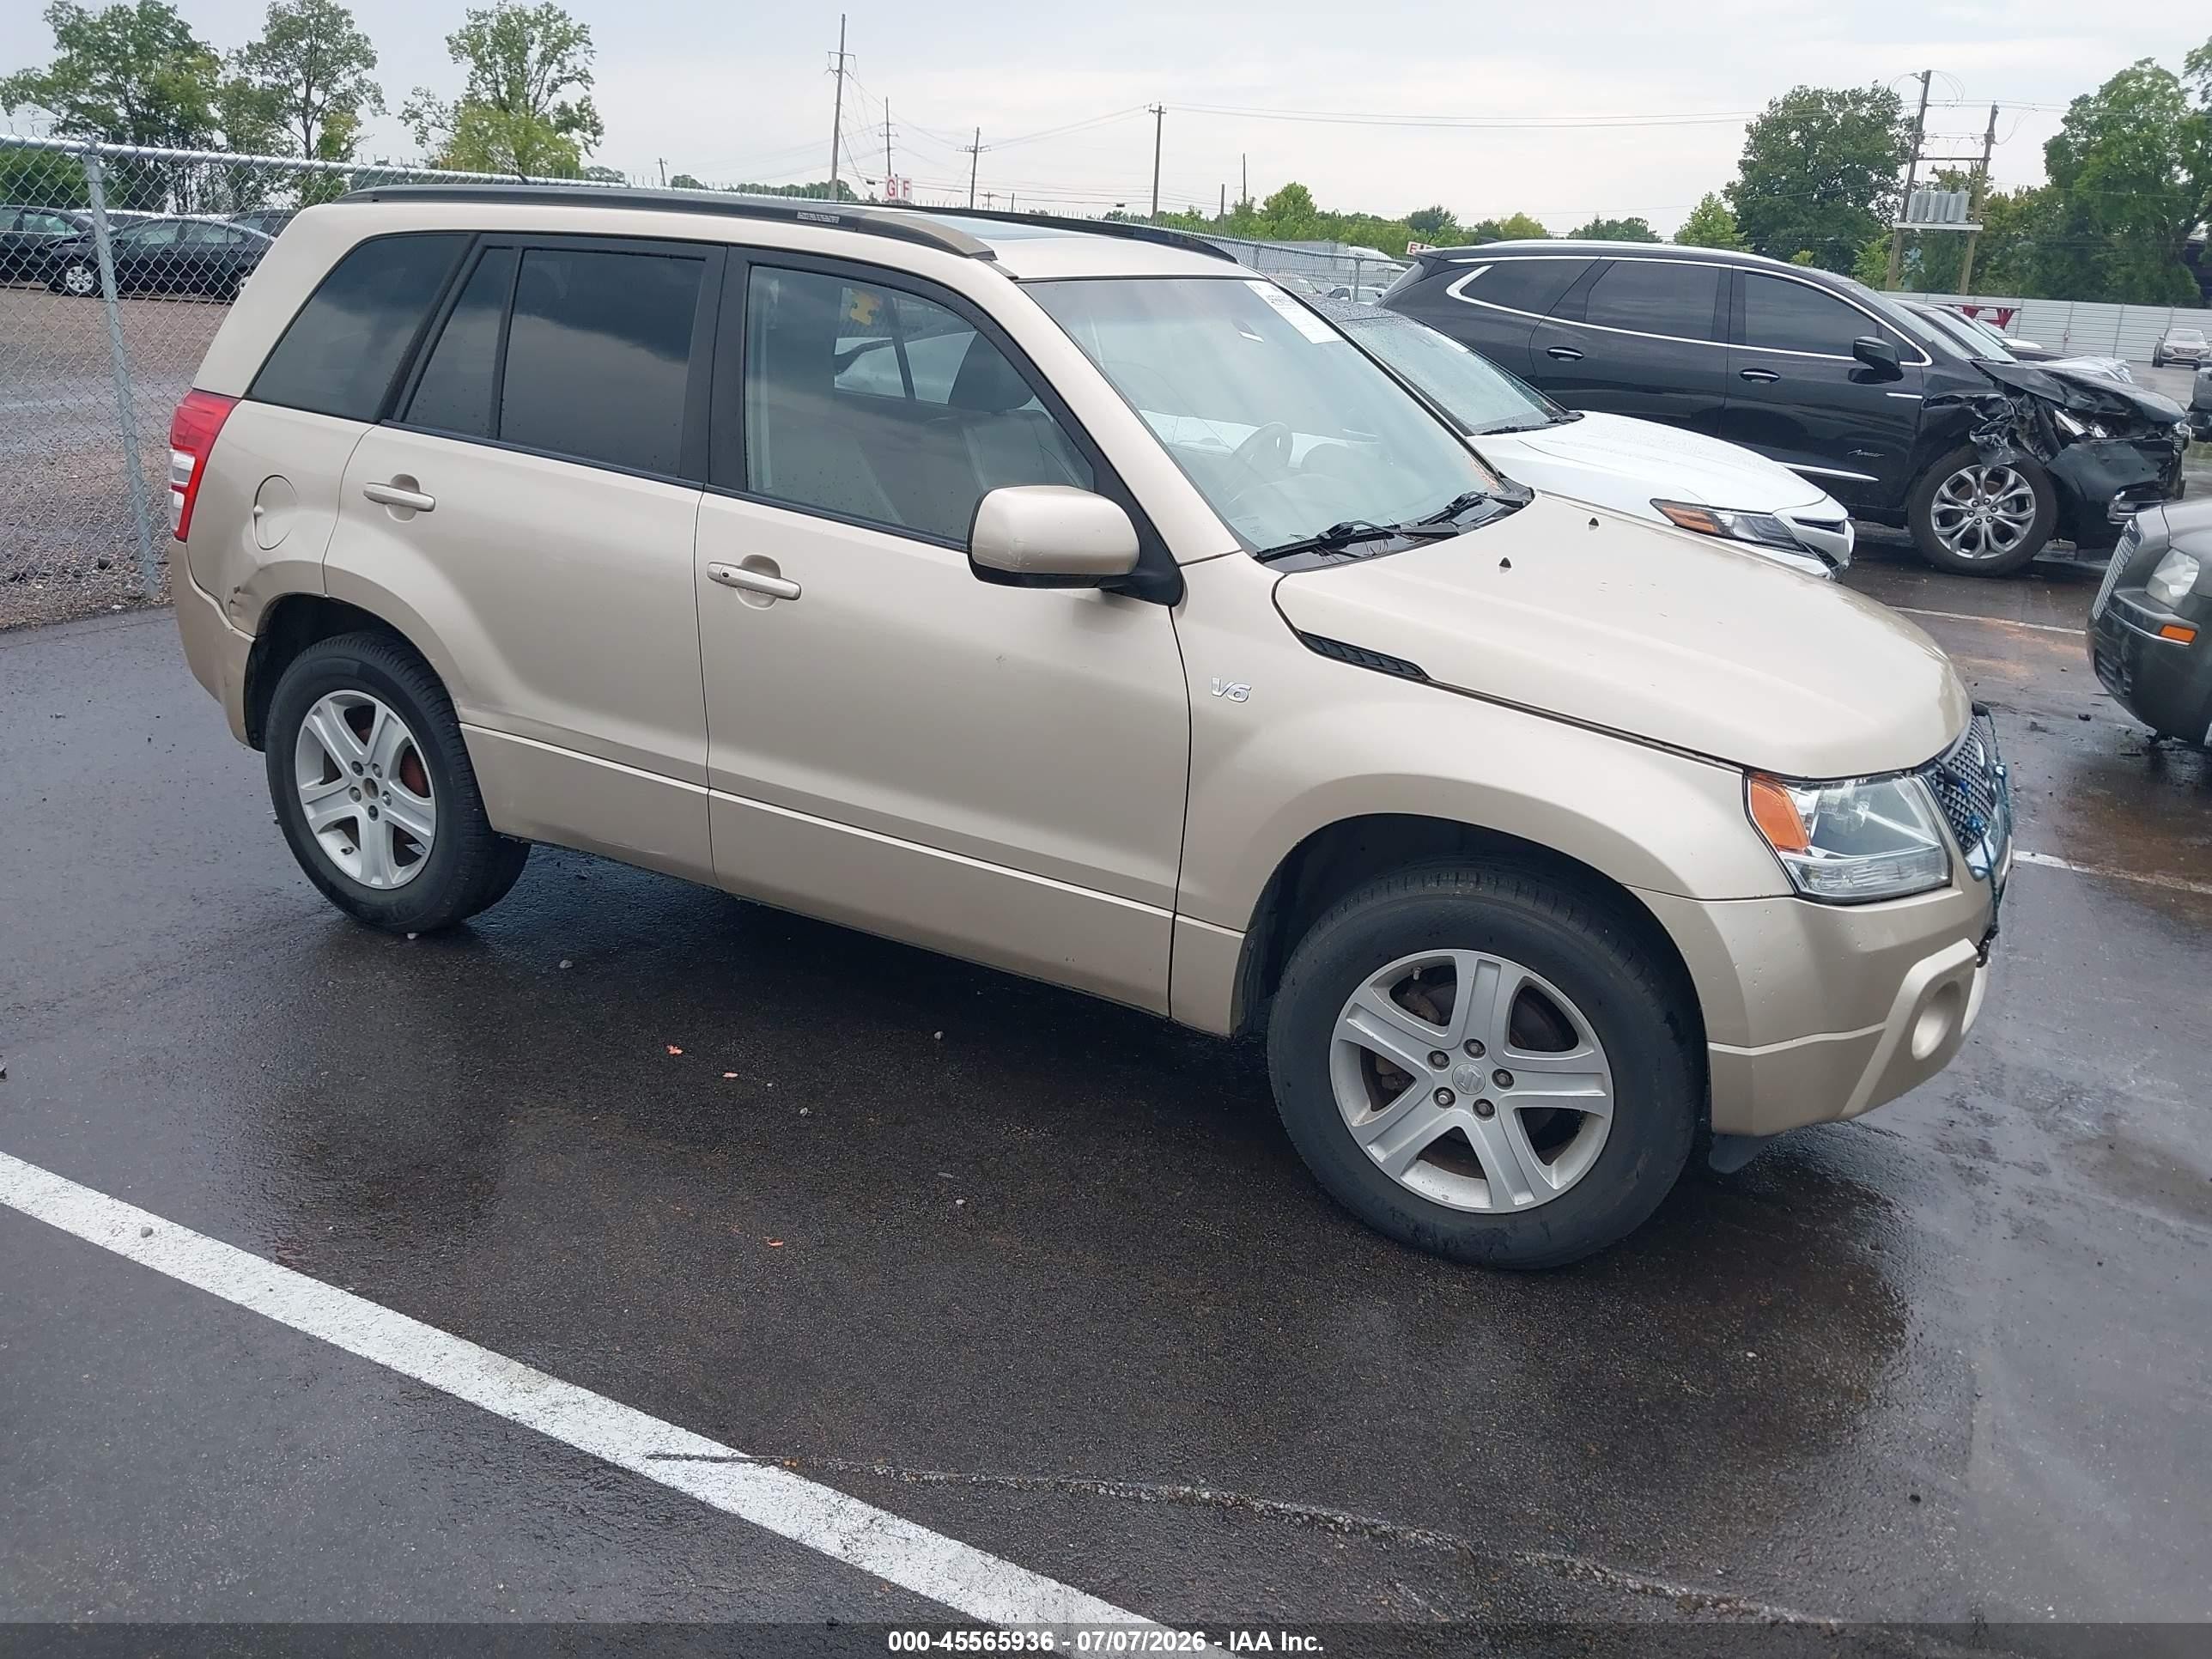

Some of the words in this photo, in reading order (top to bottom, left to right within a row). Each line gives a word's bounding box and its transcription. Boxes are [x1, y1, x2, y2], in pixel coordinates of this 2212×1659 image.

[886, 179, 896, 197] G
[902, 180, 910, 197] F
[1211, 676, 1252, 703] V6
